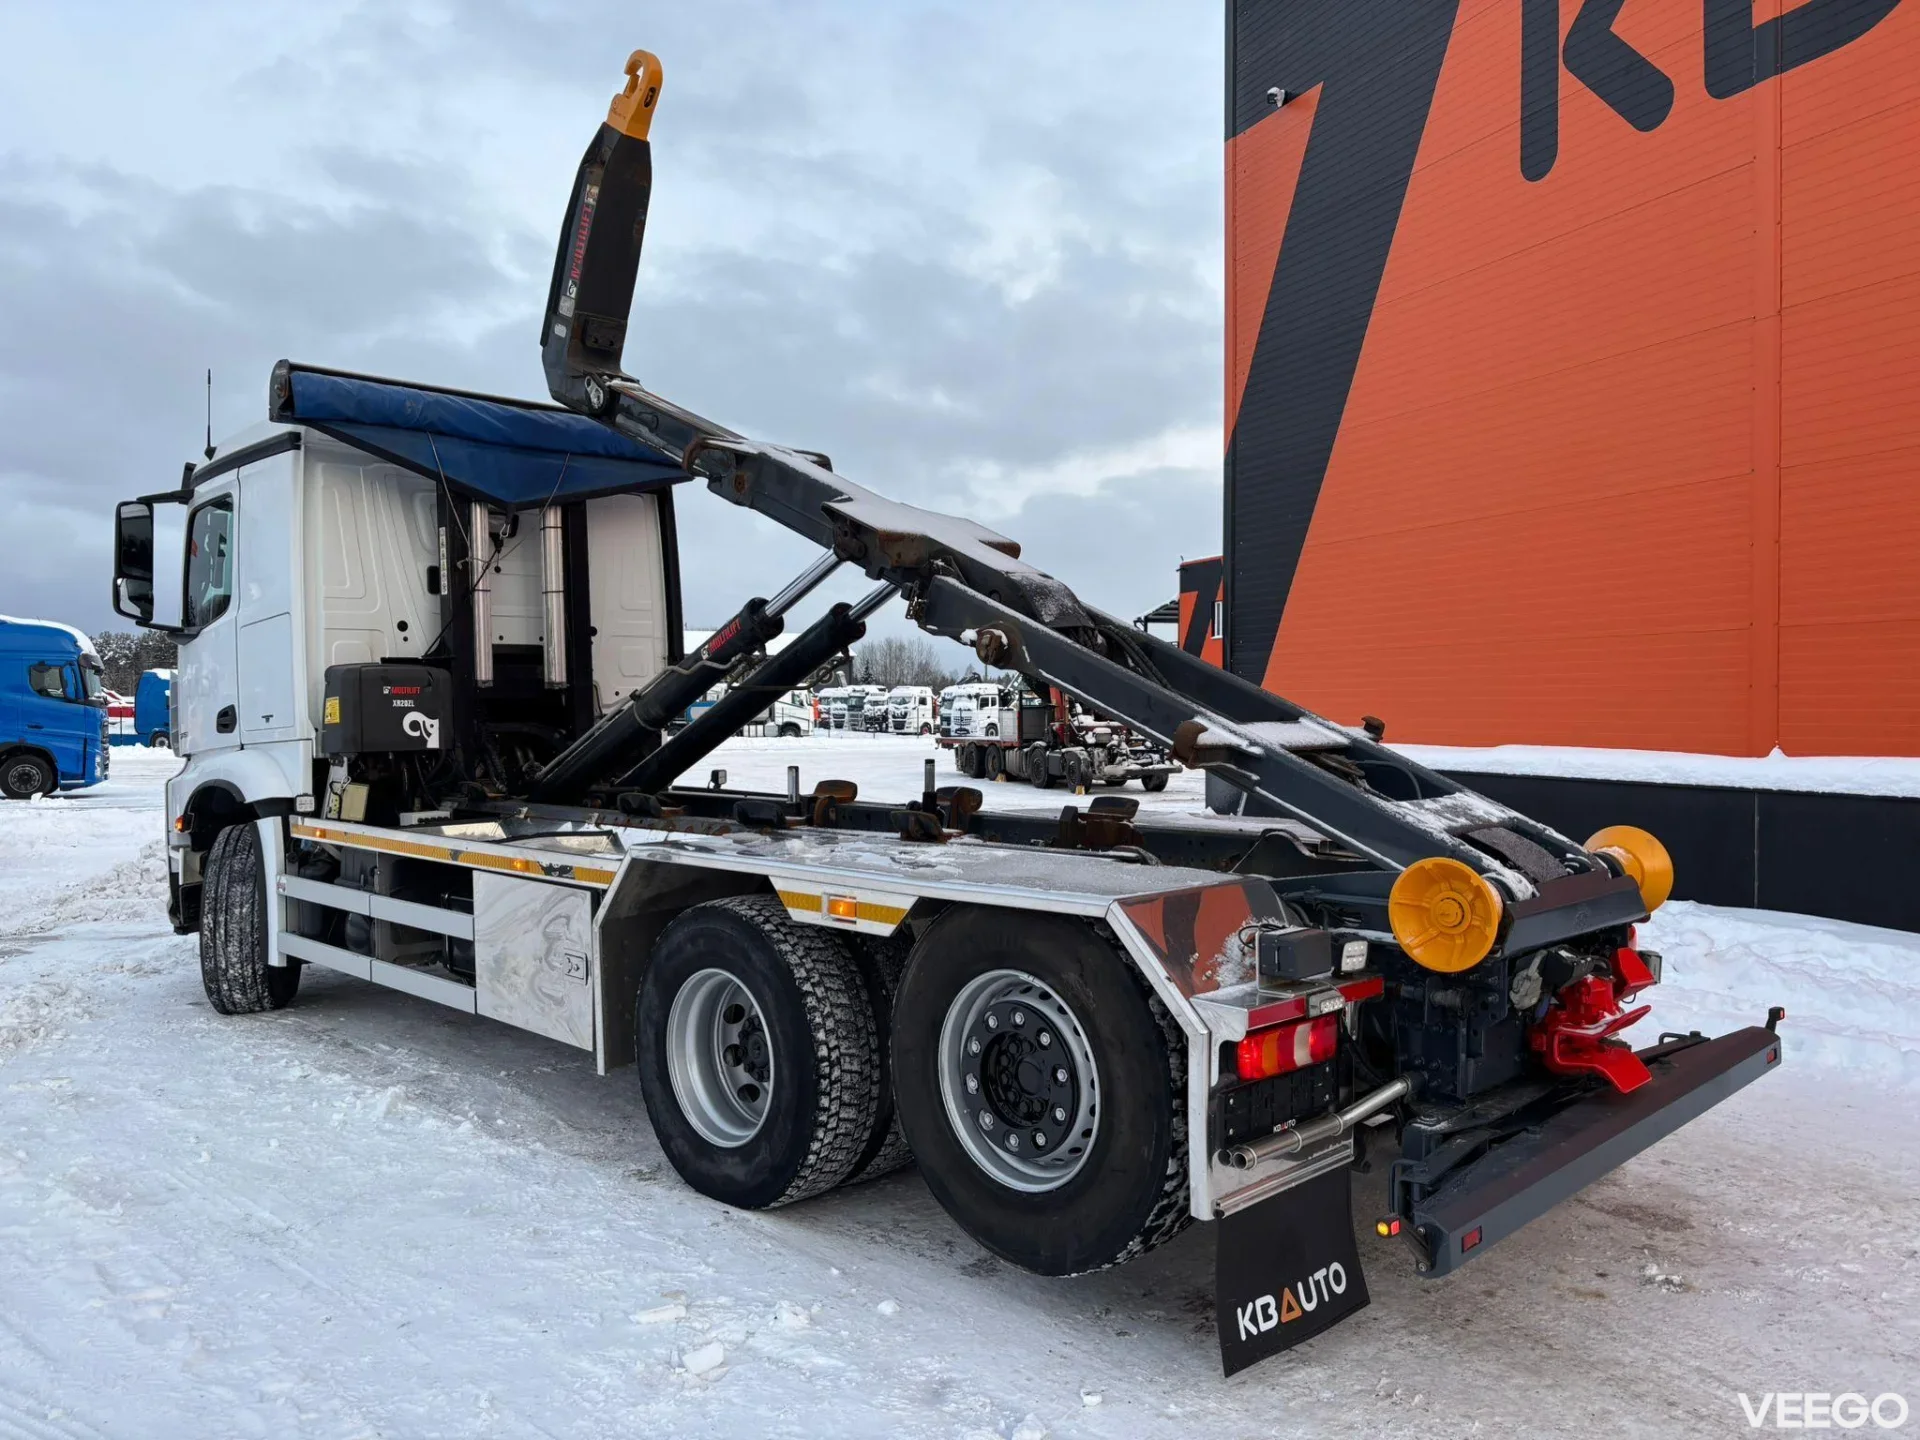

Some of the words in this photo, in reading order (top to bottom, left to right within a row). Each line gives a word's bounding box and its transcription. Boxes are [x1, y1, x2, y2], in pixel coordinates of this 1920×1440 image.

[707, 617, 742, 654] MULTILIFT
[391, 686, 421, 695] MULTILIFT
[1237, 1261, 1347, 1341] KBAUTO
